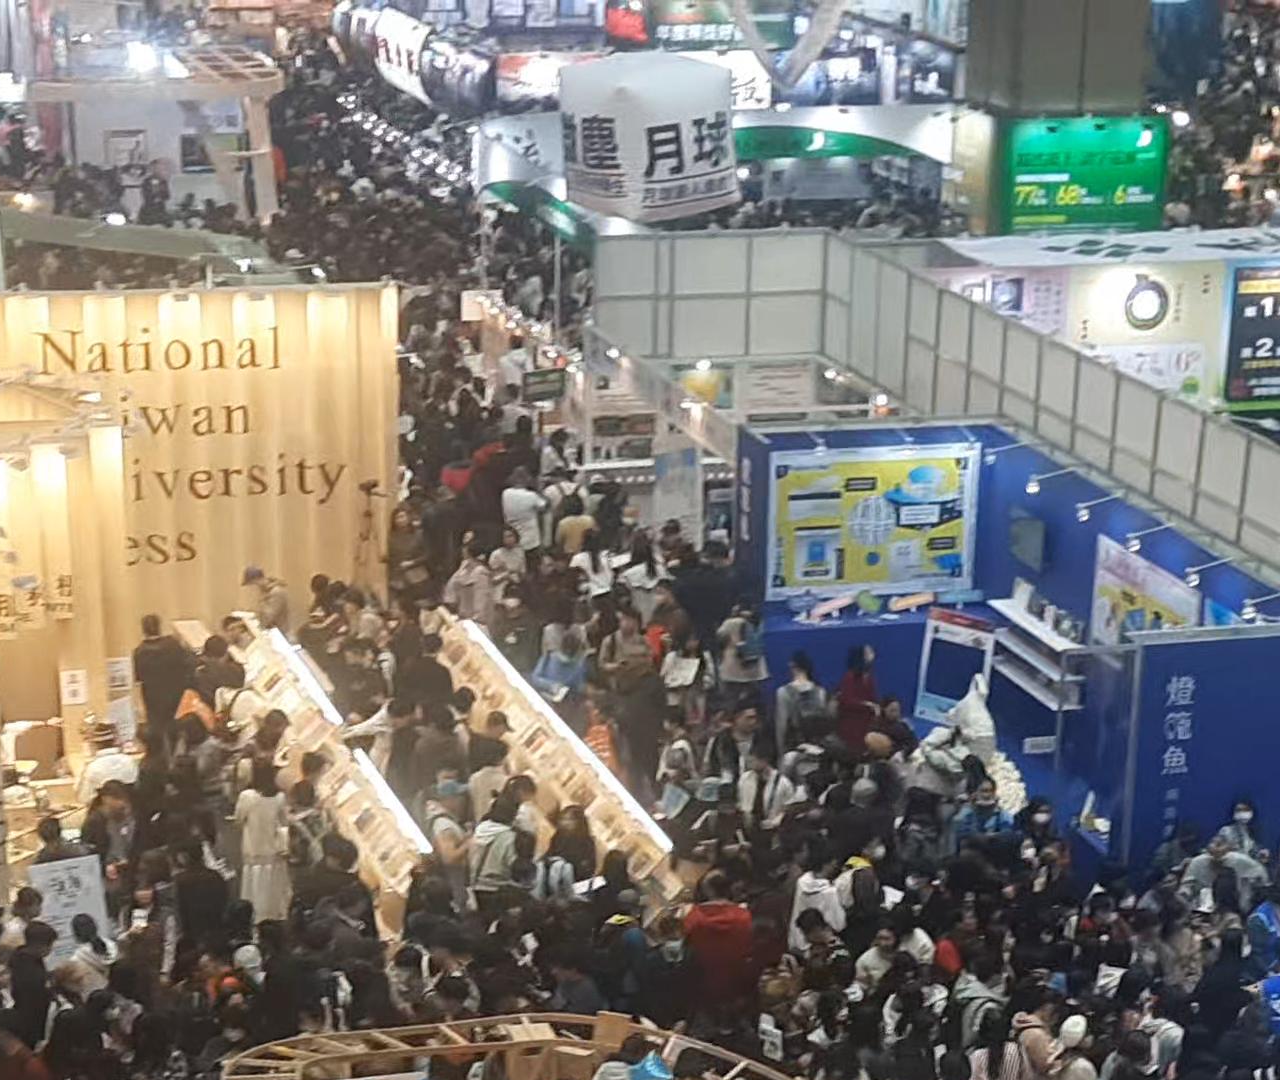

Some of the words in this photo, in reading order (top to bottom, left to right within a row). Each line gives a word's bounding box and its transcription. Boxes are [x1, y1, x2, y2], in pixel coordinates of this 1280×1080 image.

[39, 325, 282, 376] National
[121, 389, 250, 437] iwan
[133, 452, 347, 504] iversity
[125, 531, 197, 566] ess
[1161, 676, 1196, 776] 燈籠魚
